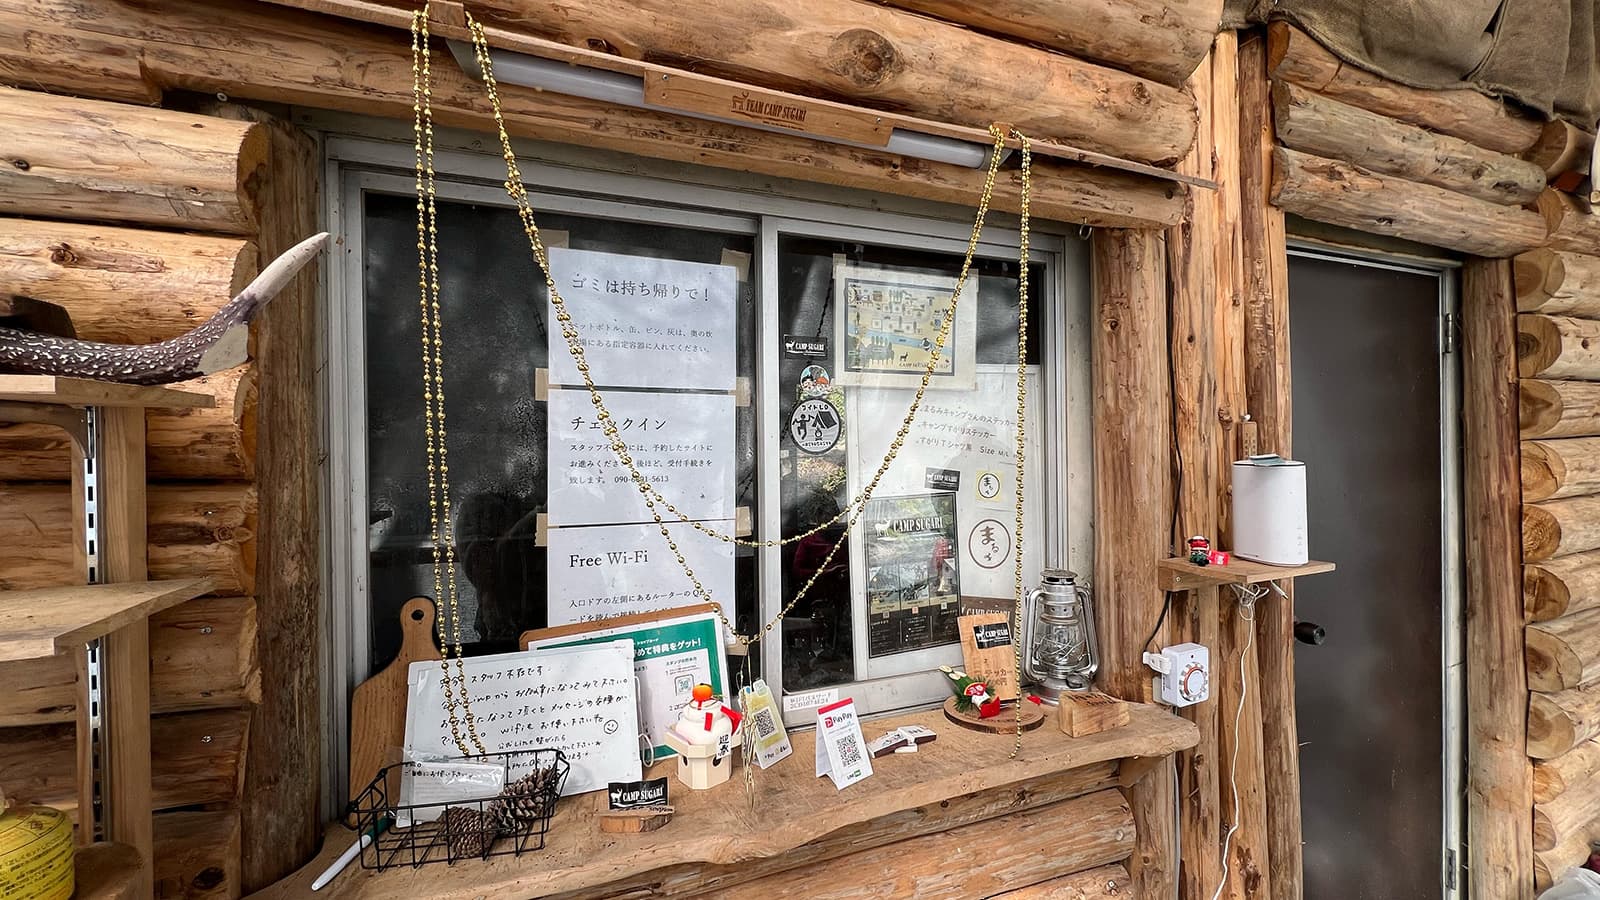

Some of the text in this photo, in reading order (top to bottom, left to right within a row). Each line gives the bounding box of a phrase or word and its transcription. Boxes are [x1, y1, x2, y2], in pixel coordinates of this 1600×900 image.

[745, 100, 807, 121] TEAM CAMP SUGARI
[572, 278, 709, 301] ゴミは持ち帰りで！
[570, 443, 713, 453] スタッフ不には、予約したサイトに
[893, 517, 944, 533] CAMP SUGARI
[569, 550, 649, 568] Free Wi-Fi
[634, 637, 701, 657] めて特典をゲット!
[833, 712, 853, 723] PayPay
[622, 786, 664, 802] CAMP SUGARI
